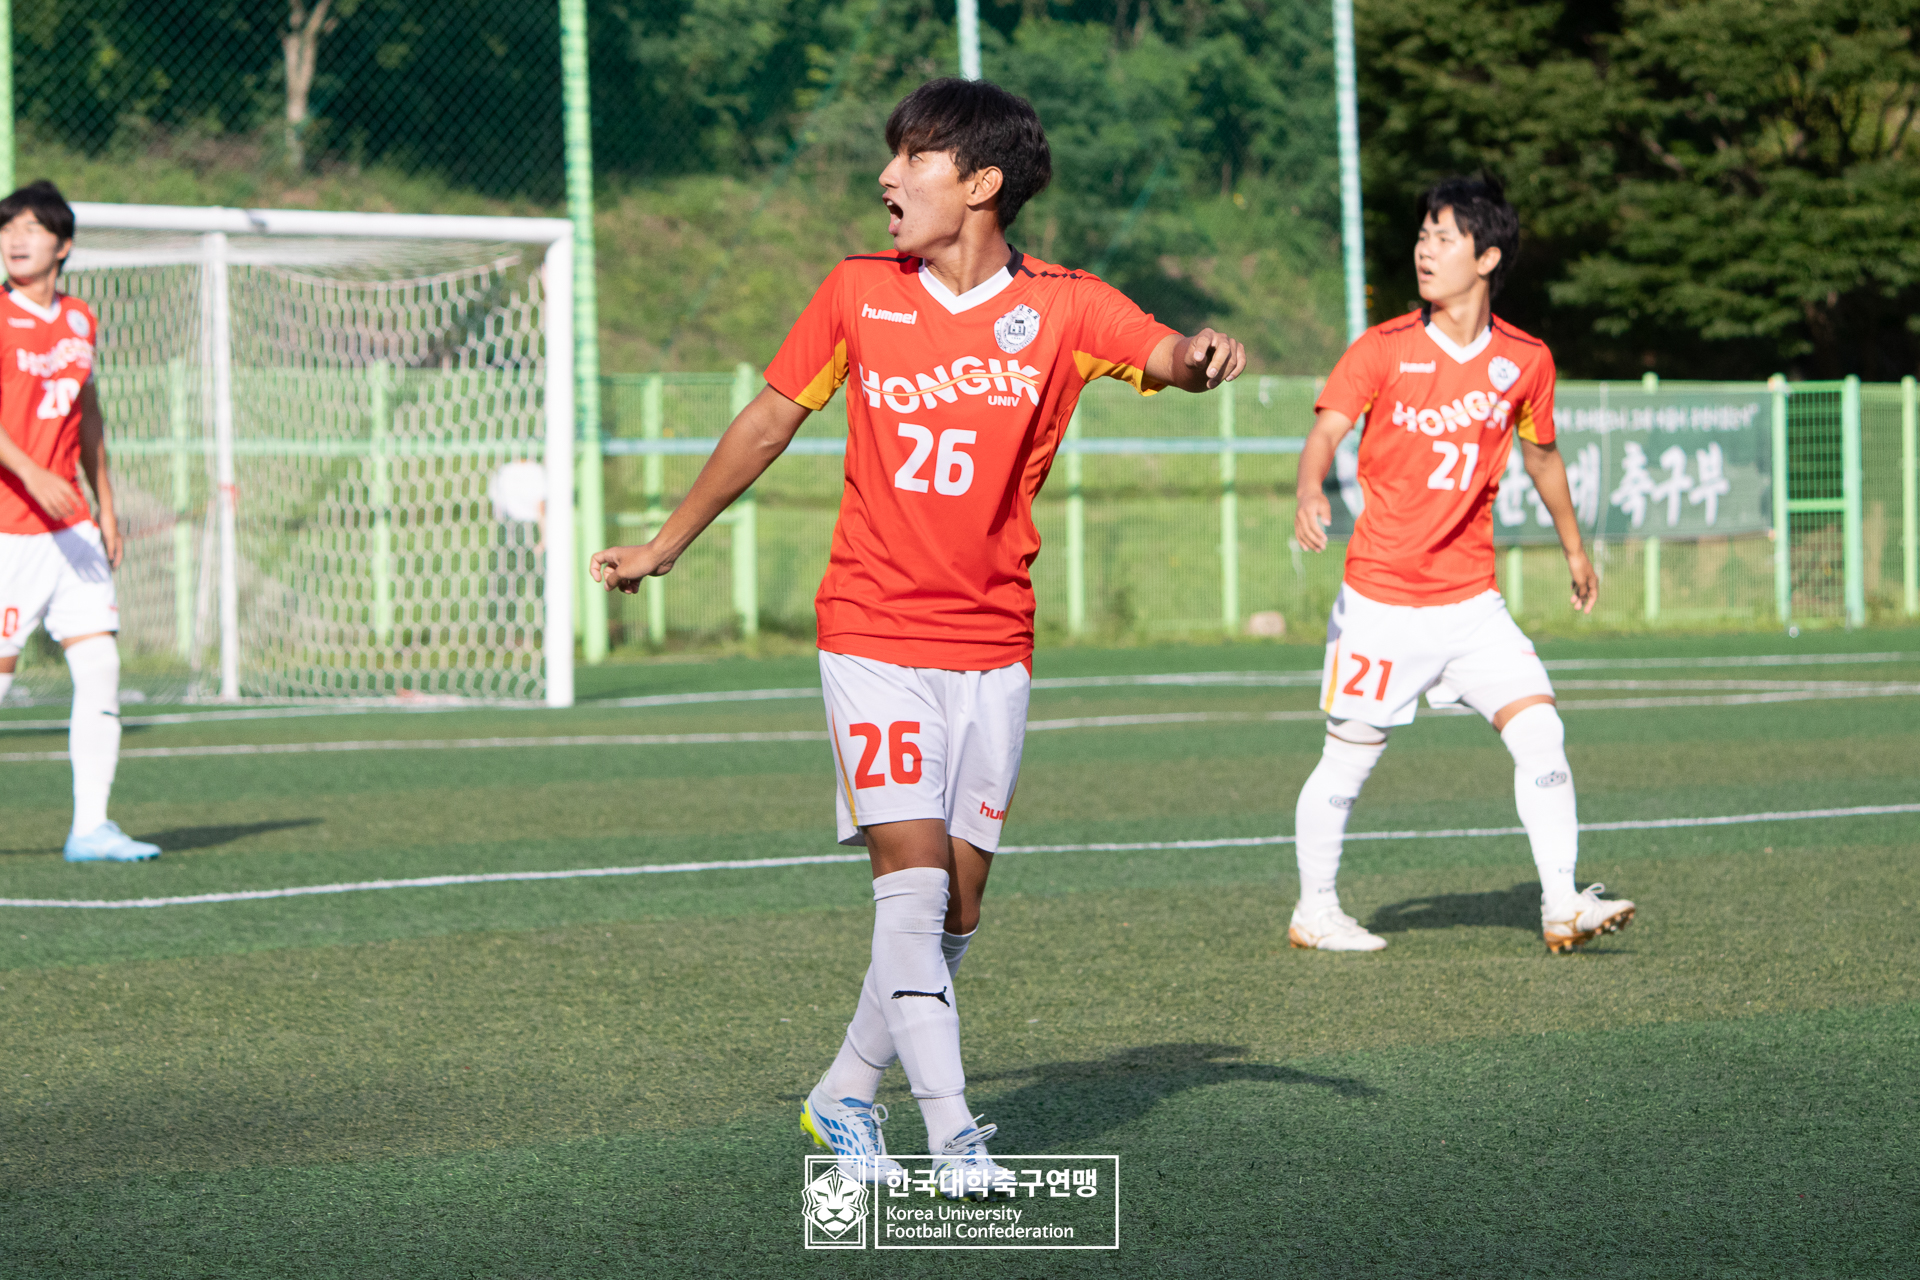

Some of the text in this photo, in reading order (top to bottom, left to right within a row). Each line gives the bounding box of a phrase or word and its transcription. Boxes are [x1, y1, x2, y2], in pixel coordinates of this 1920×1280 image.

[862, 303, 917, 325] hummel
[859, 356, 1042, 414] HONGIK
[988, 395, 1020, 408] UNIV
[894, 422, 977, 497] 26
[1427, 440, 1480, 492] 21
[1342, 652, 1393, 702] 21
[849, 720, 923, 790] 26
